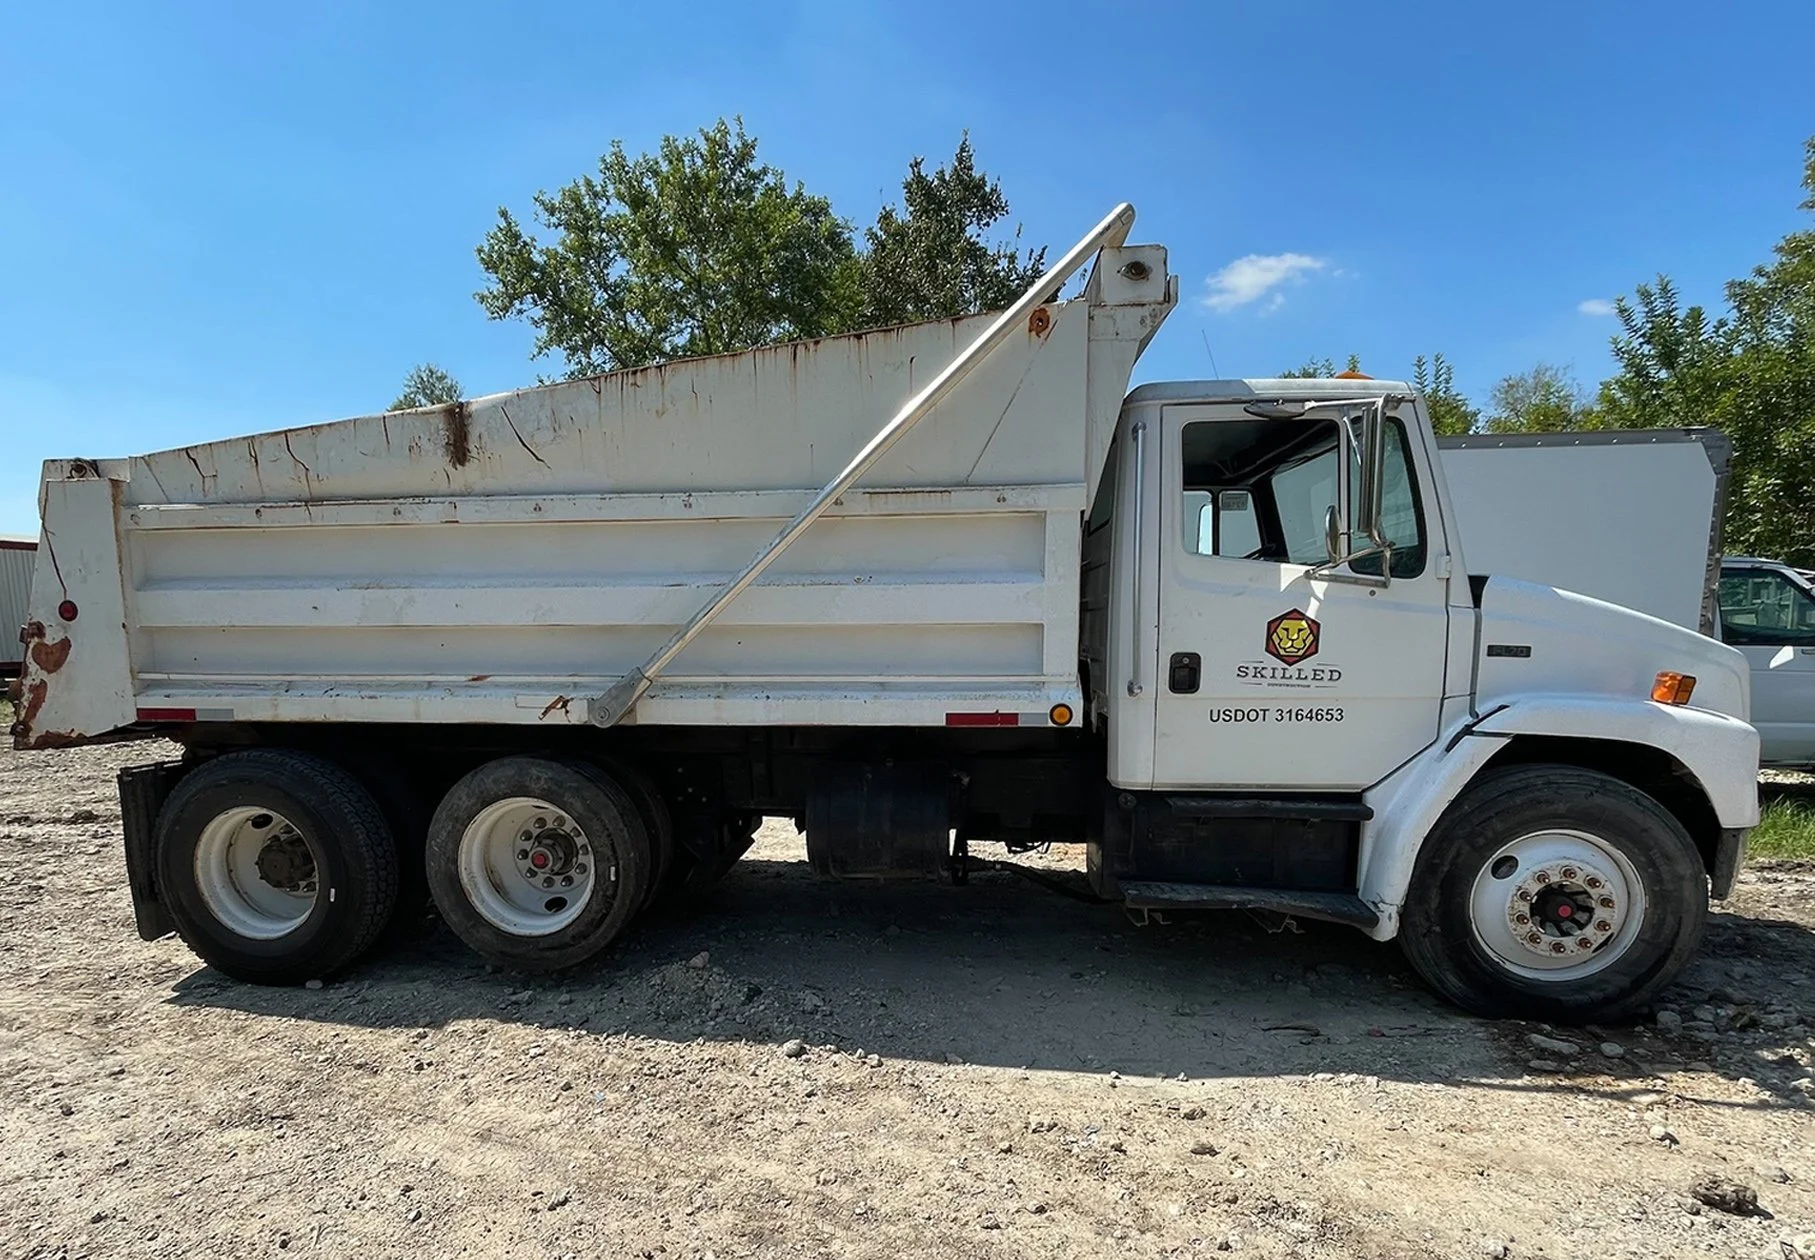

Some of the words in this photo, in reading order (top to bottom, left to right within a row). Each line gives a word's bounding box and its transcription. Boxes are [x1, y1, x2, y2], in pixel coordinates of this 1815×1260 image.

[1236, 665, 1342, 682] SKILLED
[1209, 708, 1271, 723] USDOT
[1274, 707, 1345, 723] 3164653
